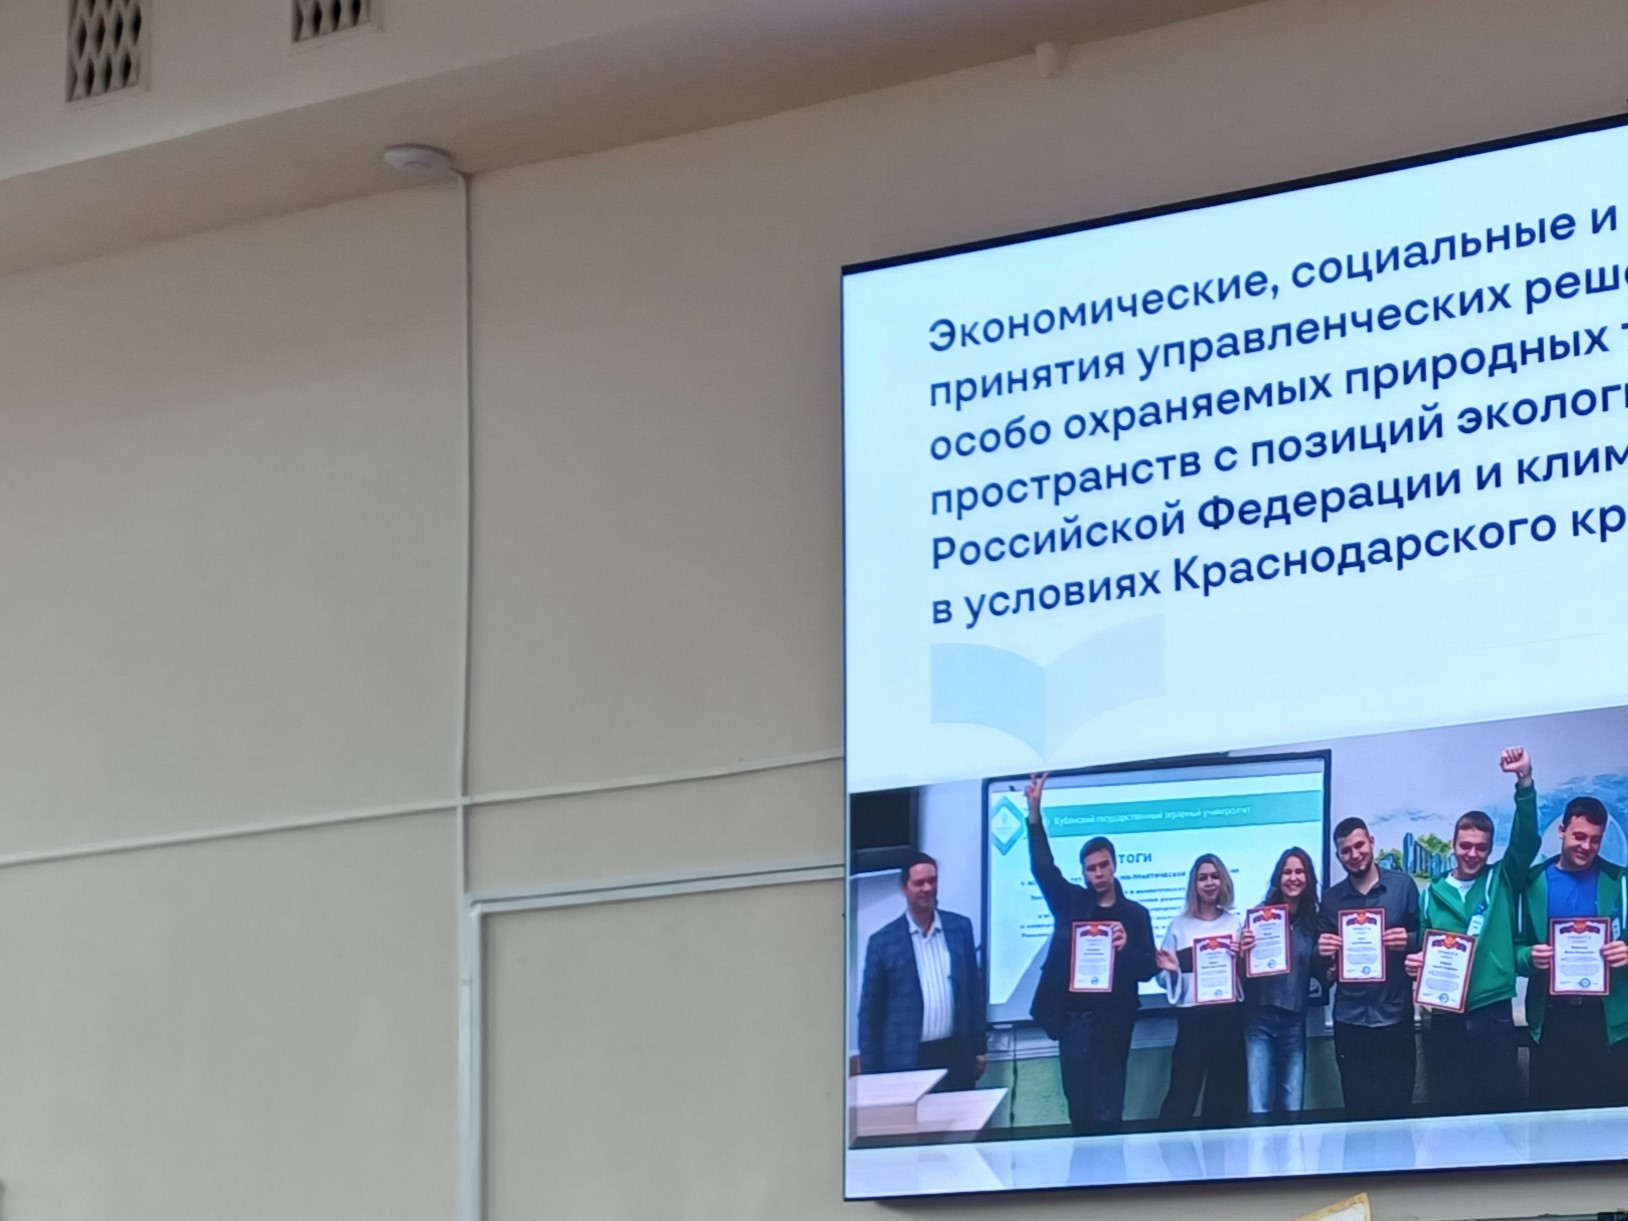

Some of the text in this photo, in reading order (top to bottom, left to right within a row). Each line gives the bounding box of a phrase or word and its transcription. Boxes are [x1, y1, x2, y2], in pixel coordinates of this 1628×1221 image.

[928, 270, 1280, 352] Экономические,
[1291, 212, 1577, 289] социальные
[1590, 204, 1618, 235] и
[929, 414, 1052, 461] особо
[1063, 372, 1333, 442] охраняемых
[1345, 325, 1611, 401] природных
[930, 350, 1125, 413] принятия
[1136, 282, 1513, 382] управленческих
[931, 450, 1202, 521] пространств
[1213, 445, 1238, 473] с
[1251, 401, 1444, 468] позиций
[932, 498, 1185, 570] Российской
[1197, 468, 1462, 531] Федерации
[1475, 461, 1502, 491] и
[932, 599, 953, 625] в
[963, 569, 1162, 630] условиях
[1173, 513, 1557, 598] Краснодарского
[1117, 853, 1152, 864] ТОГИ
